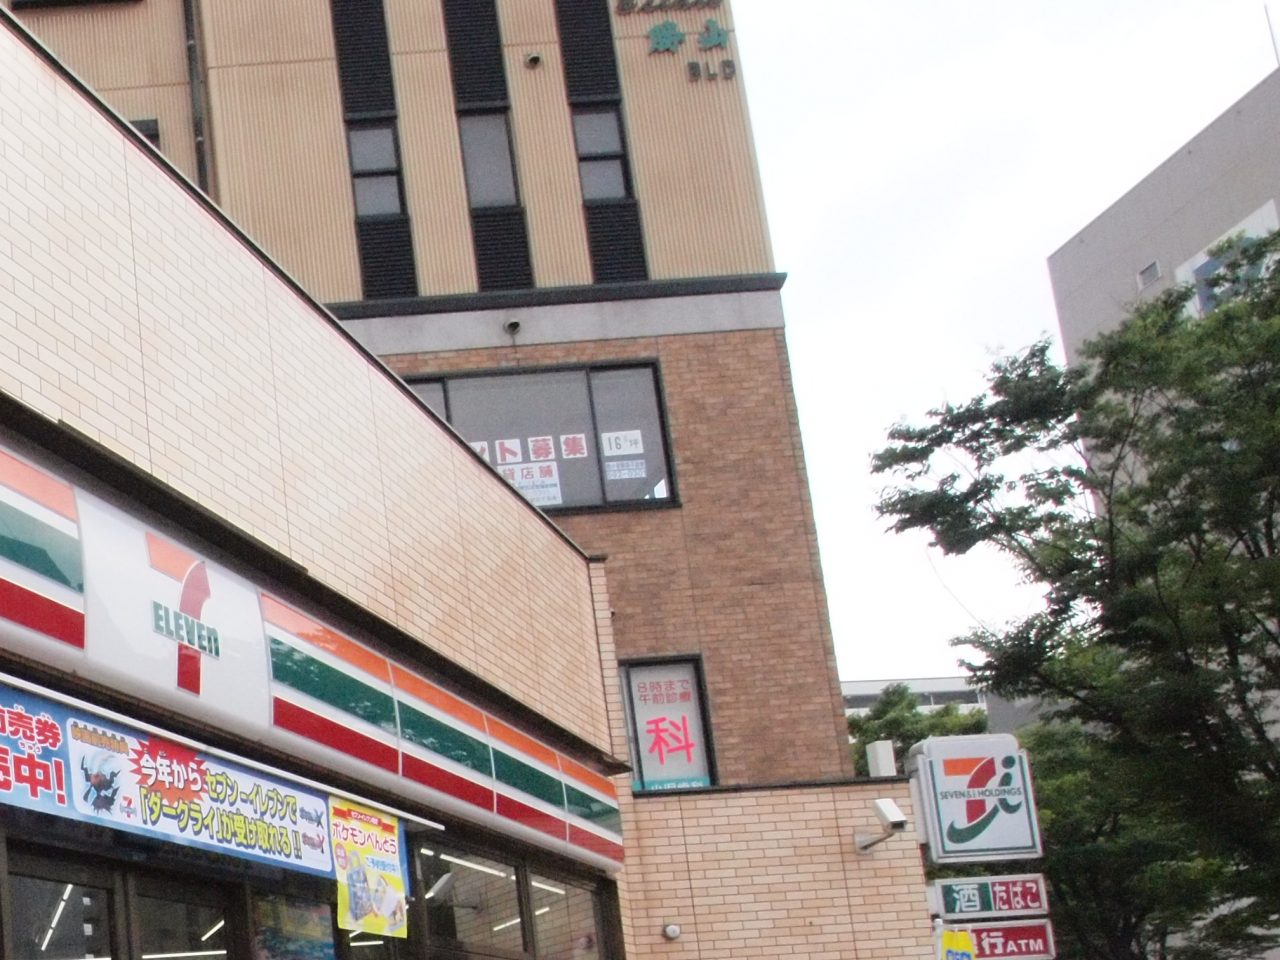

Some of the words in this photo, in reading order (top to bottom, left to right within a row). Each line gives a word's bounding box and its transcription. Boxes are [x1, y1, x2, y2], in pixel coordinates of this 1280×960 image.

[645, 713, 695, 766] 科
[139, 752, 202, 791] 今年から
[953, 884, 981, 912] 酒
